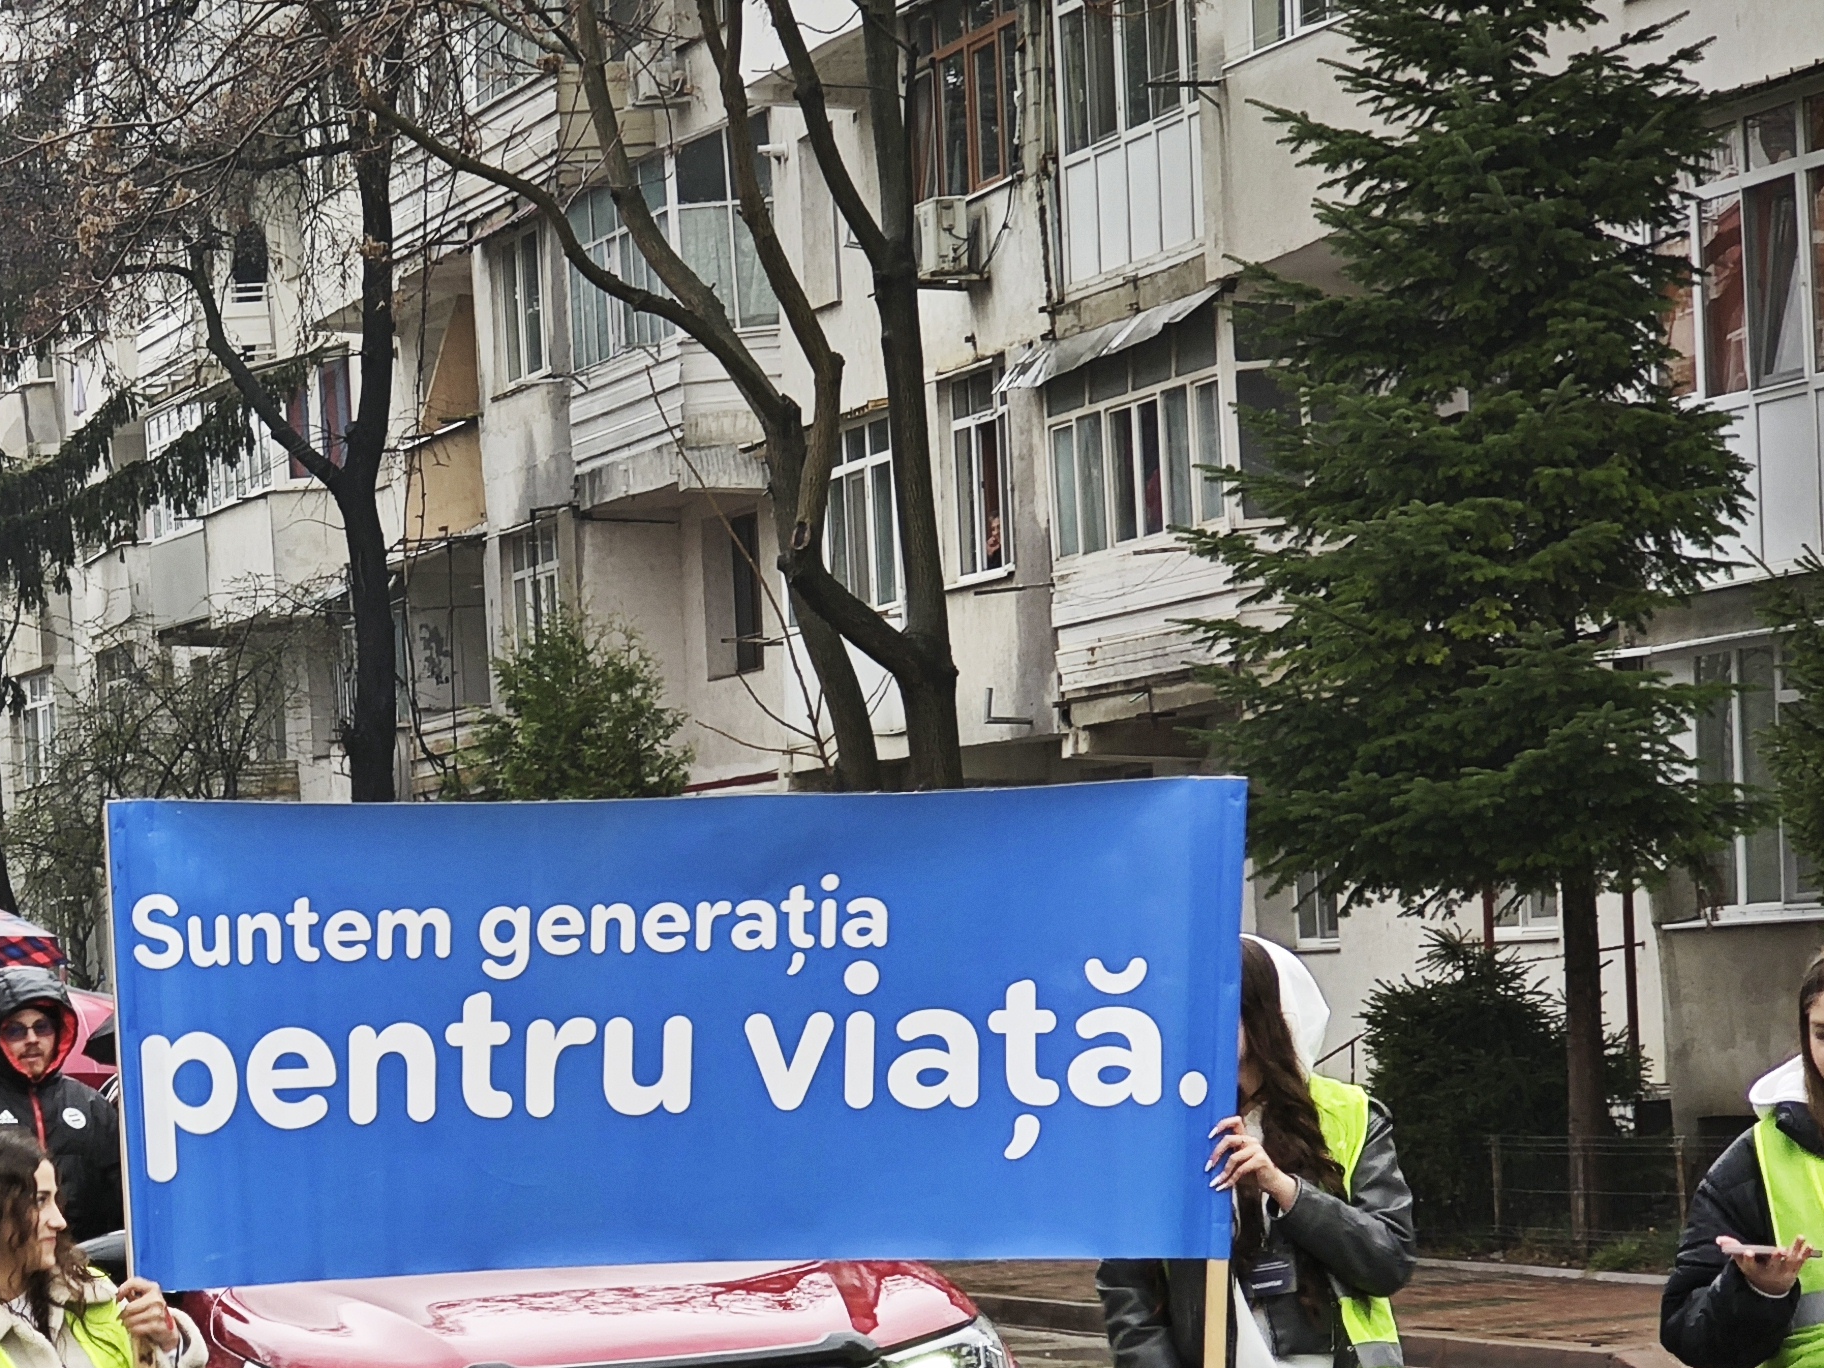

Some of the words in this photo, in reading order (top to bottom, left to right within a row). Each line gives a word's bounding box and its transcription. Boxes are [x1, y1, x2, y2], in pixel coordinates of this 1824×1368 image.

[132, 892, 452, 970] Suntem
[478, 873, 889, 980] generația
[140, 990, 693, 1183] pentru
[743, 956, 1210, 1160] viață.
